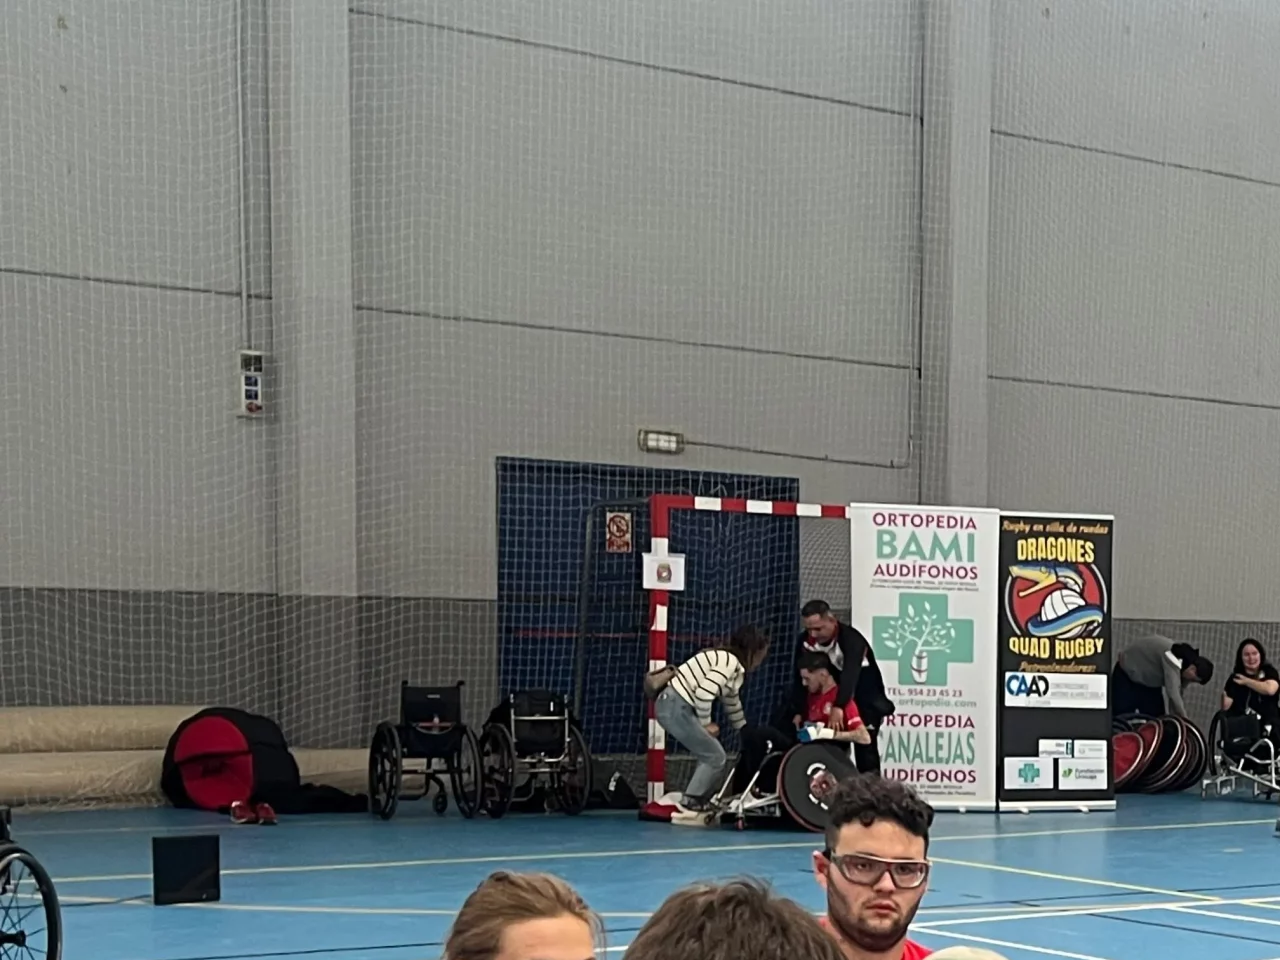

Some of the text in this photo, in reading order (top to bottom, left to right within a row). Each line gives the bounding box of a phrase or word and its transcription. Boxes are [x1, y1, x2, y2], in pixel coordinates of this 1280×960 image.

[872, 512, 977, 530] ORTOPEDIA
[876, 529, 975, 563] BAMI
[1017, 537, 1095, 563] DRAGONES
[873, 560, 978, 580] AUDÍFONOS
[1009, 636, 1104, 660] QUAD RUGBY
[887, 687, 963, 698] TEL. 954 23 45 23
[886, 713, 975, 729] RTOPEDIA
[880, 730, 975, 766] ANALEJAS
[884, 762, 977, 784] UDÍFONOS
